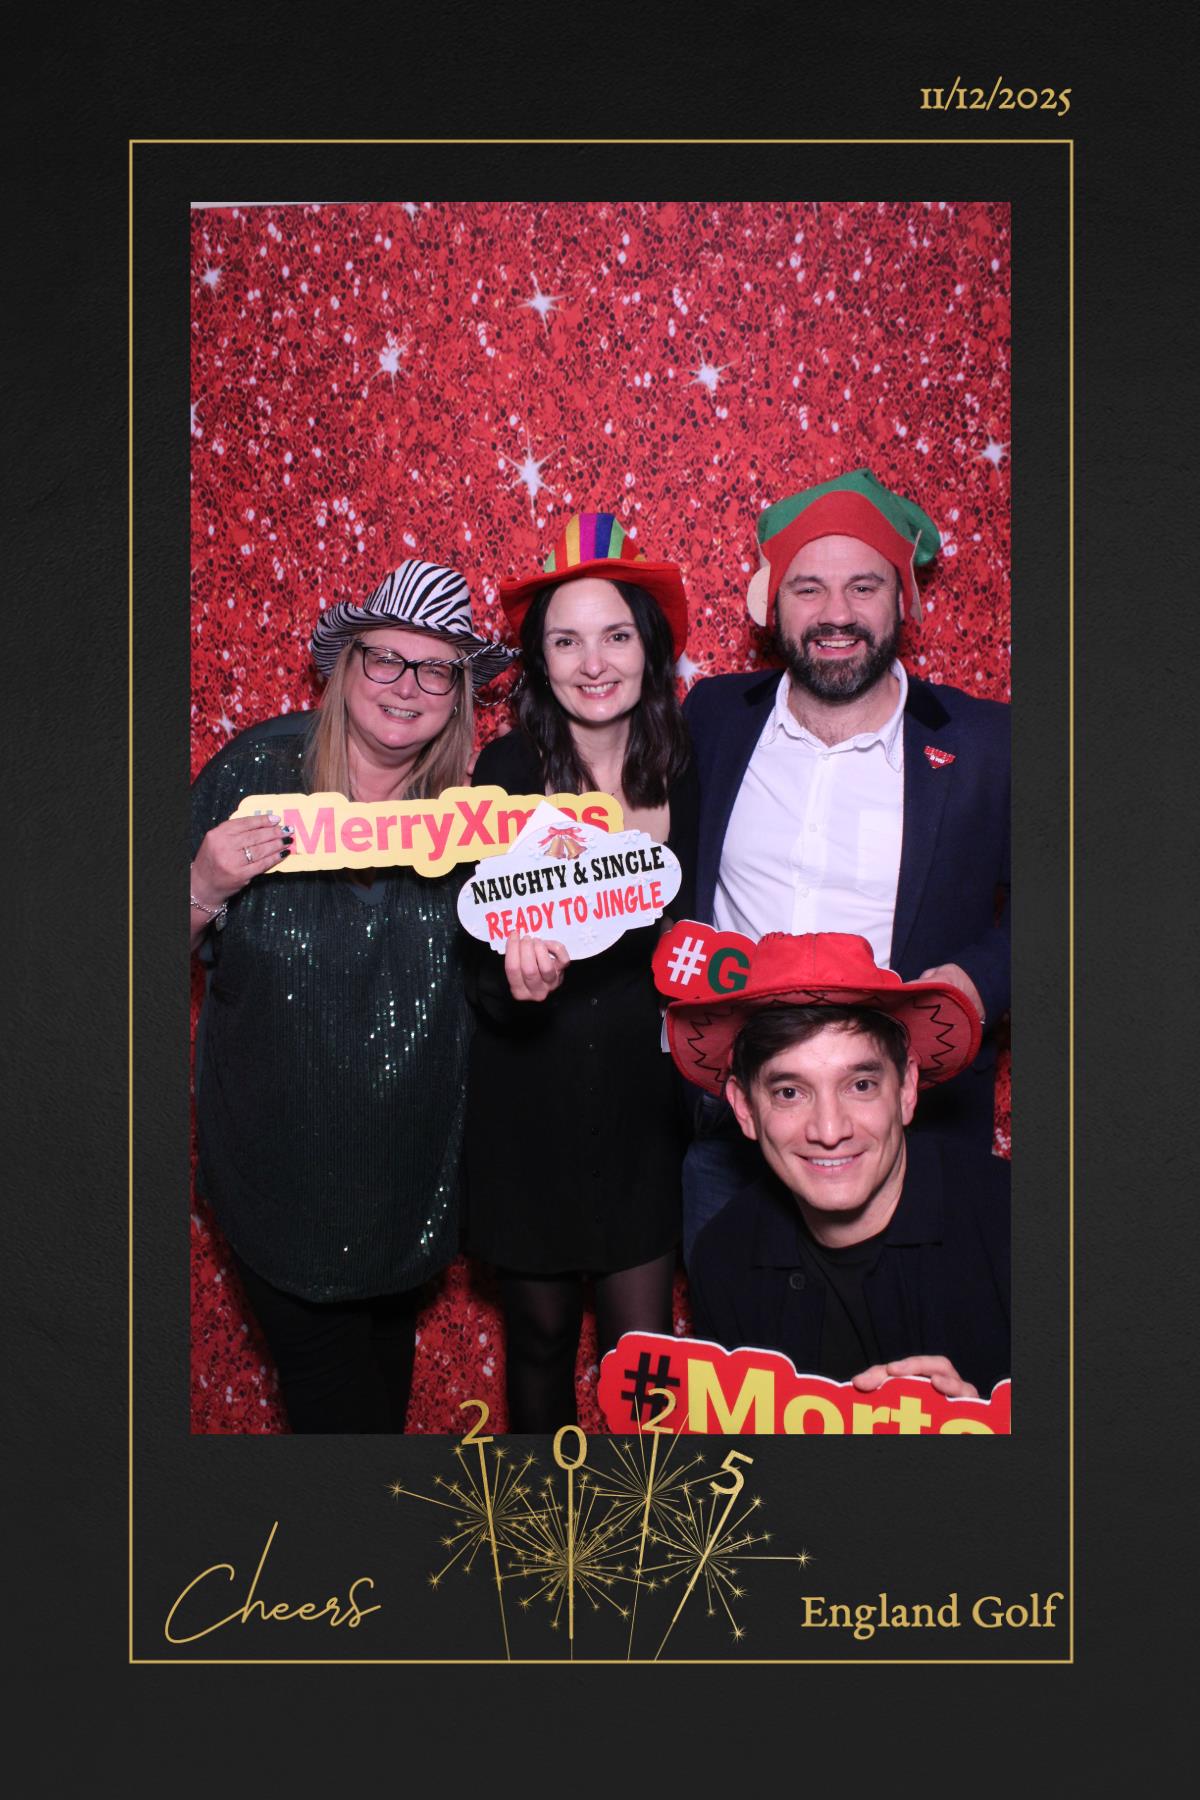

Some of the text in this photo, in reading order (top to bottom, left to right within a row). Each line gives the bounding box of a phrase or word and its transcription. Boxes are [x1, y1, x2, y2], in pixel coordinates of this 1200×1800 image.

[471, 846, 664, 904] NAUGHTY & SINGLE
[485, 881, 664, 940] READY TO JINGLE
